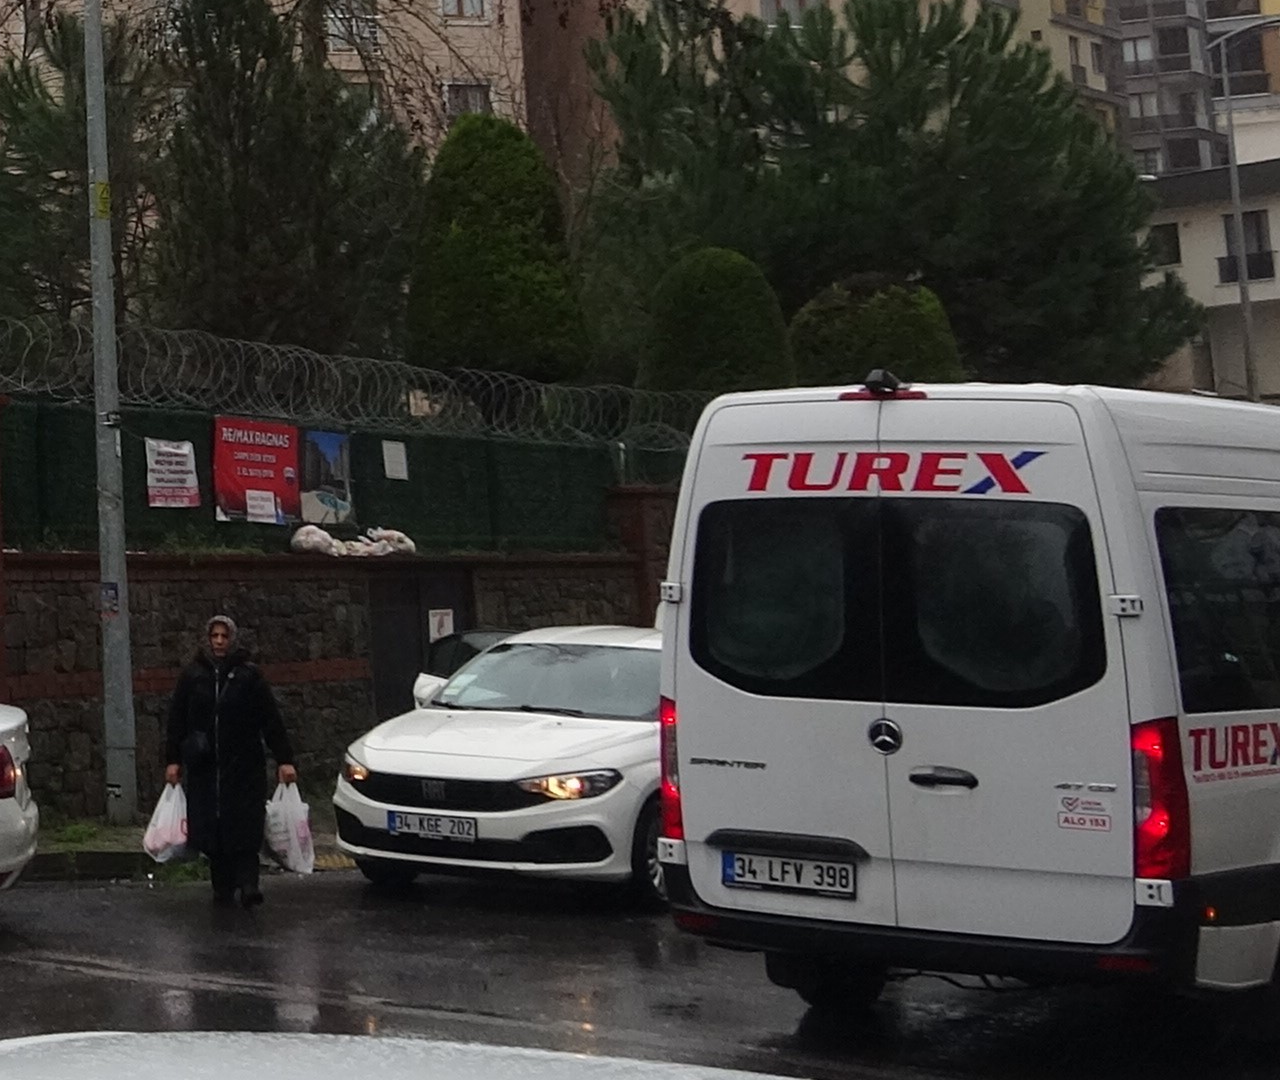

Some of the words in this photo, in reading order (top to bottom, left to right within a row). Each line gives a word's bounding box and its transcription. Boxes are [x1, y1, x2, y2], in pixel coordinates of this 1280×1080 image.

[222, 427, 255, 444] RE/MAX
[255, 431, 289, 448] RAGNAS
[742, 450, 1048, 495] TUREX
[689, 757, 767, 770] SPRINTER
[396, 814, 411, 830] 34
[418, 818, 442, 833] KGE
[449, 820, 473, 837] 202
[1063, 816, 1086, 826] ALO
[735, 857, 757, 879] 34
[768, 860, 803, 884] LFV
[813, 864, 849, 889] 398
